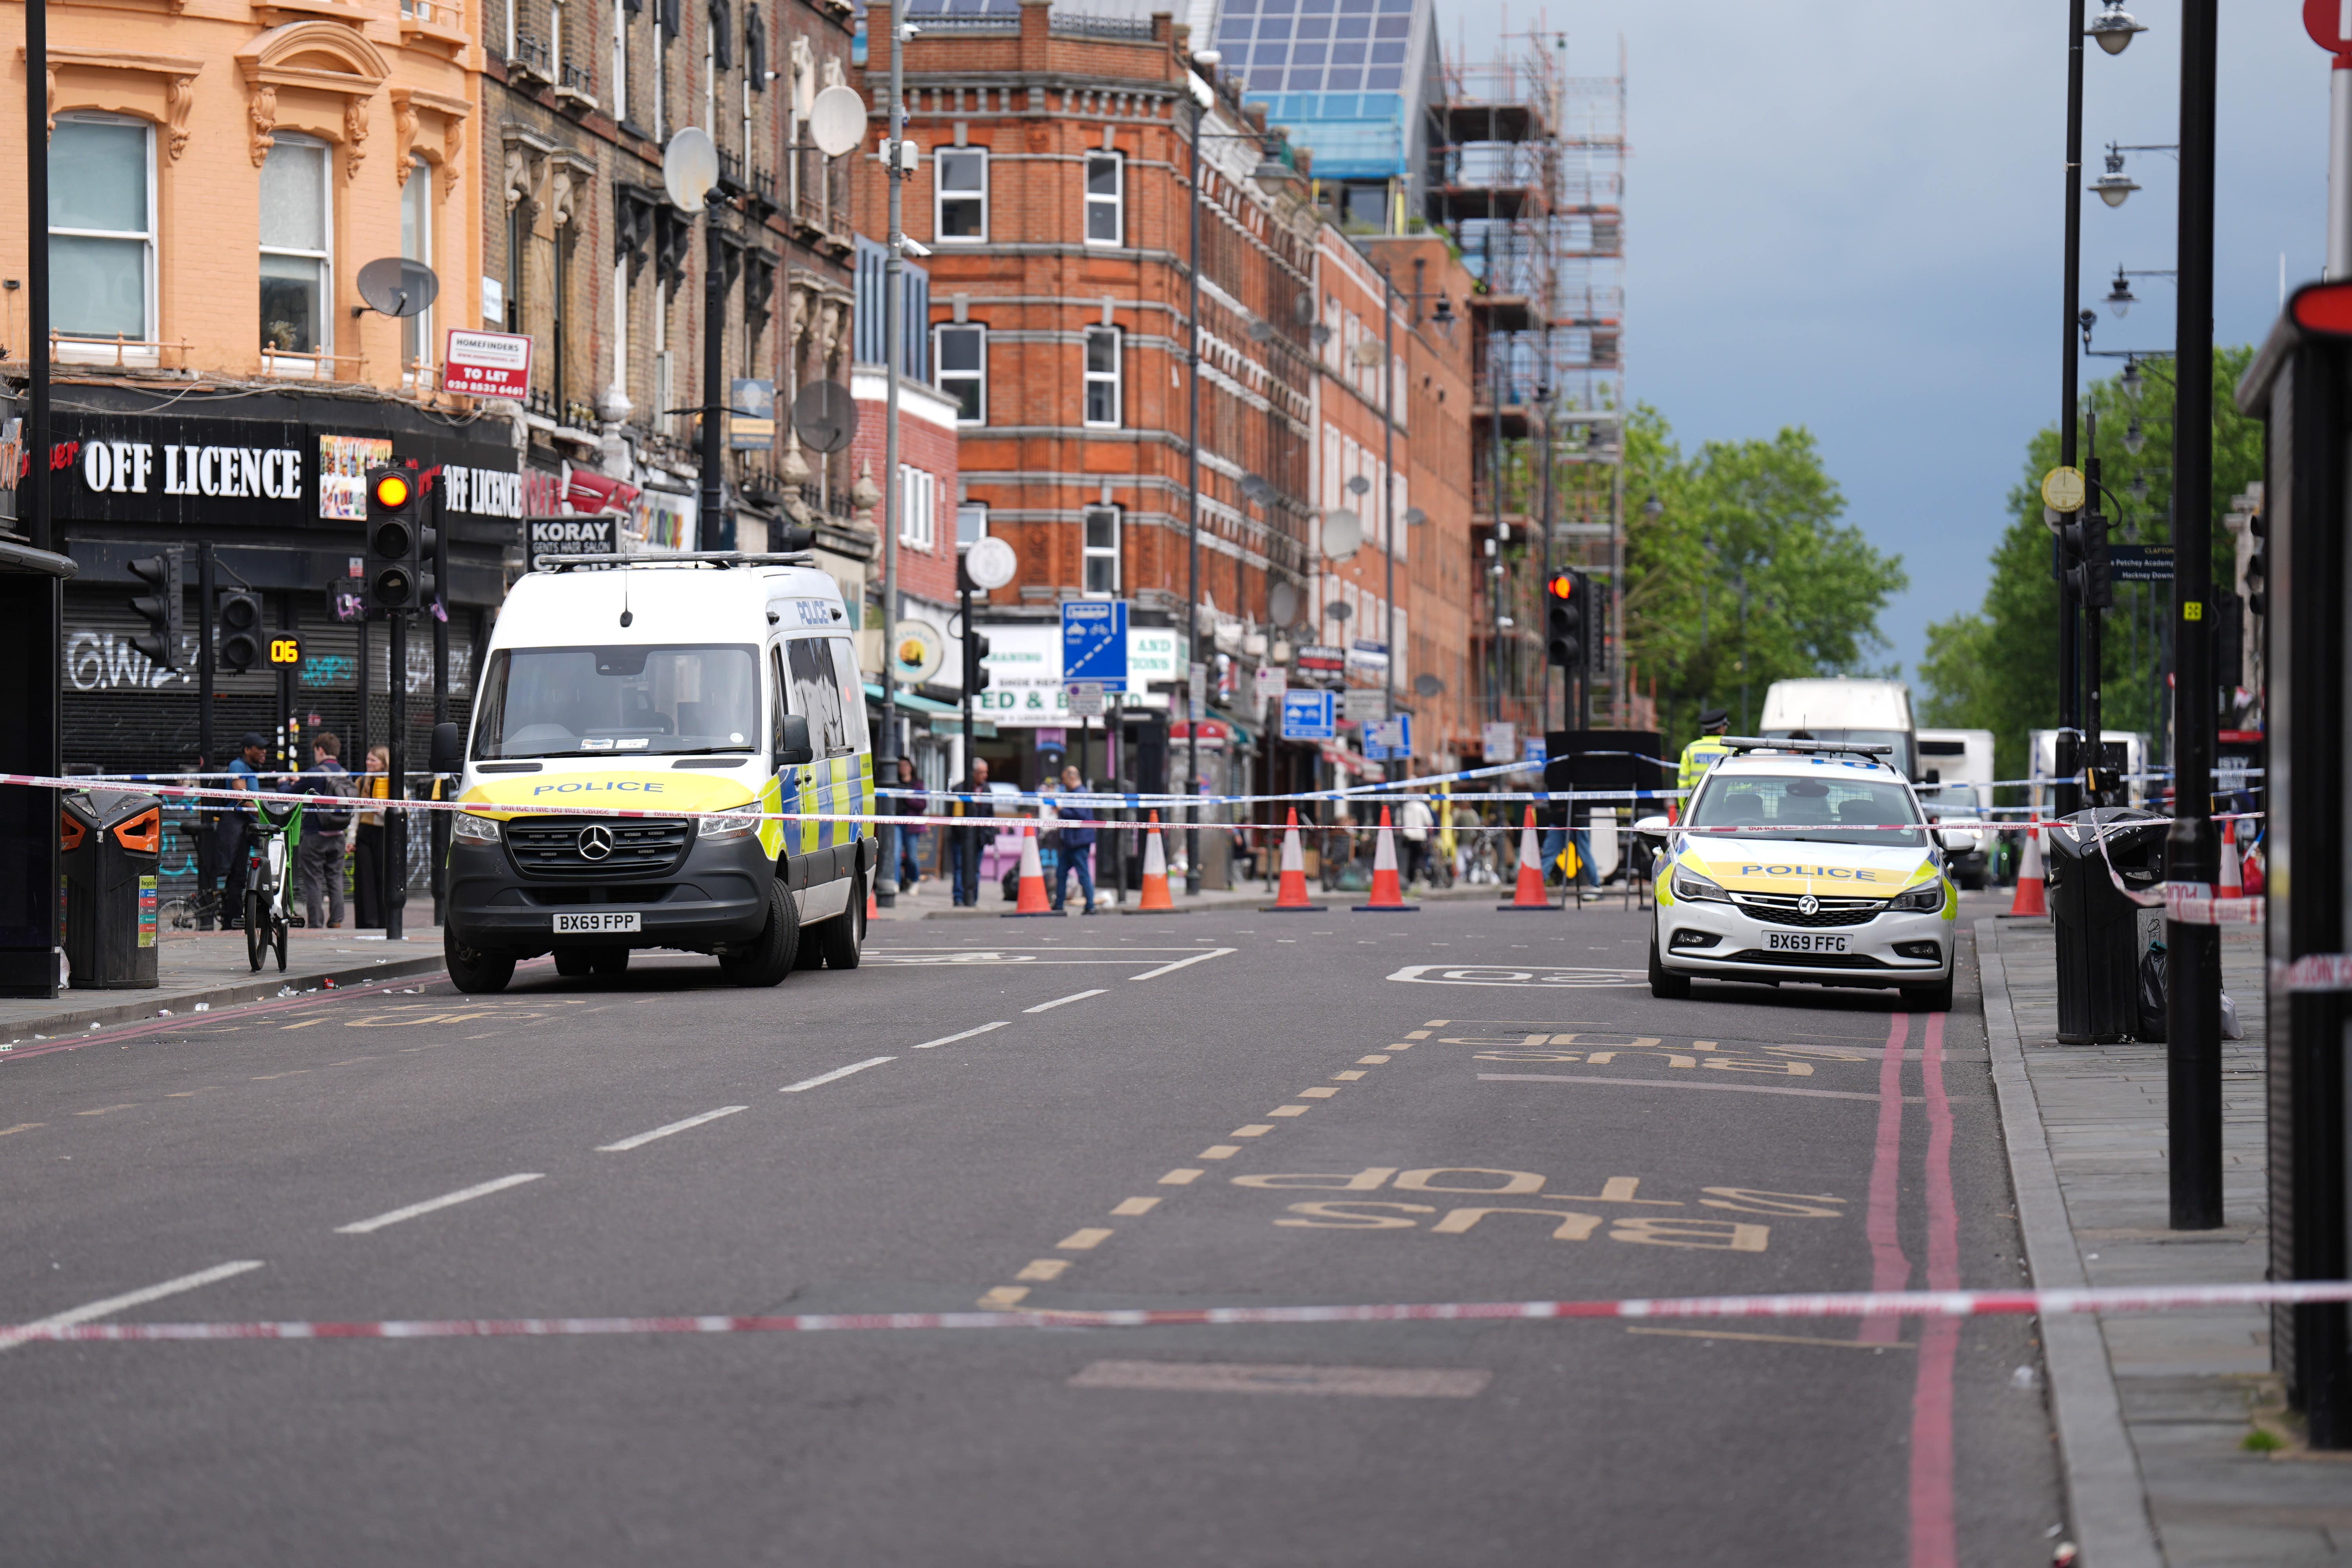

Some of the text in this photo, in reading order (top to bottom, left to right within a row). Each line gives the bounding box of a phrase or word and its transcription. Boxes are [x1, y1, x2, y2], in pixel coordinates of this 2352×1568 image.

[456, 338, 519, 352] HOMEFINDERS
[463, 367, 509, 383] TO LET
[447, 379, 524, 396] 020 8533 6461
[84, 441, 153, 493] OFF
[164, 445, 302, 499] LICENCE
[442, 464, 469, 513] OFF
[471, 467, 523, 519] LICENCE
[532, 522, 610, 541] KORAY
[532, 541, 611, 554] GENTS HAIR SALON
[2116, 559, 2142, 568] Petchey
[2144, 559, 2174, 568] Academy
[2122, 571, 2151, 580] Hackney
[796, 601, 829, 625] POLICE
[271, 641, 298, 662] 06
[1137, 639, 1172, 652] AND
[1026, 691, 1044, 709] &
[533, 782, 665, 796] POLICE
[1742, 865, 1877, 882] POLICE
[560, 915, 633, 930] BX69 FPP
[1770, 934, 1846, 951] BX69 FFG
[1472, 1049, 1815, 1076] BUS
[1229, 1166, 1848, 1218] STOP
[1272, 1200, 1771, 1252] BUS
